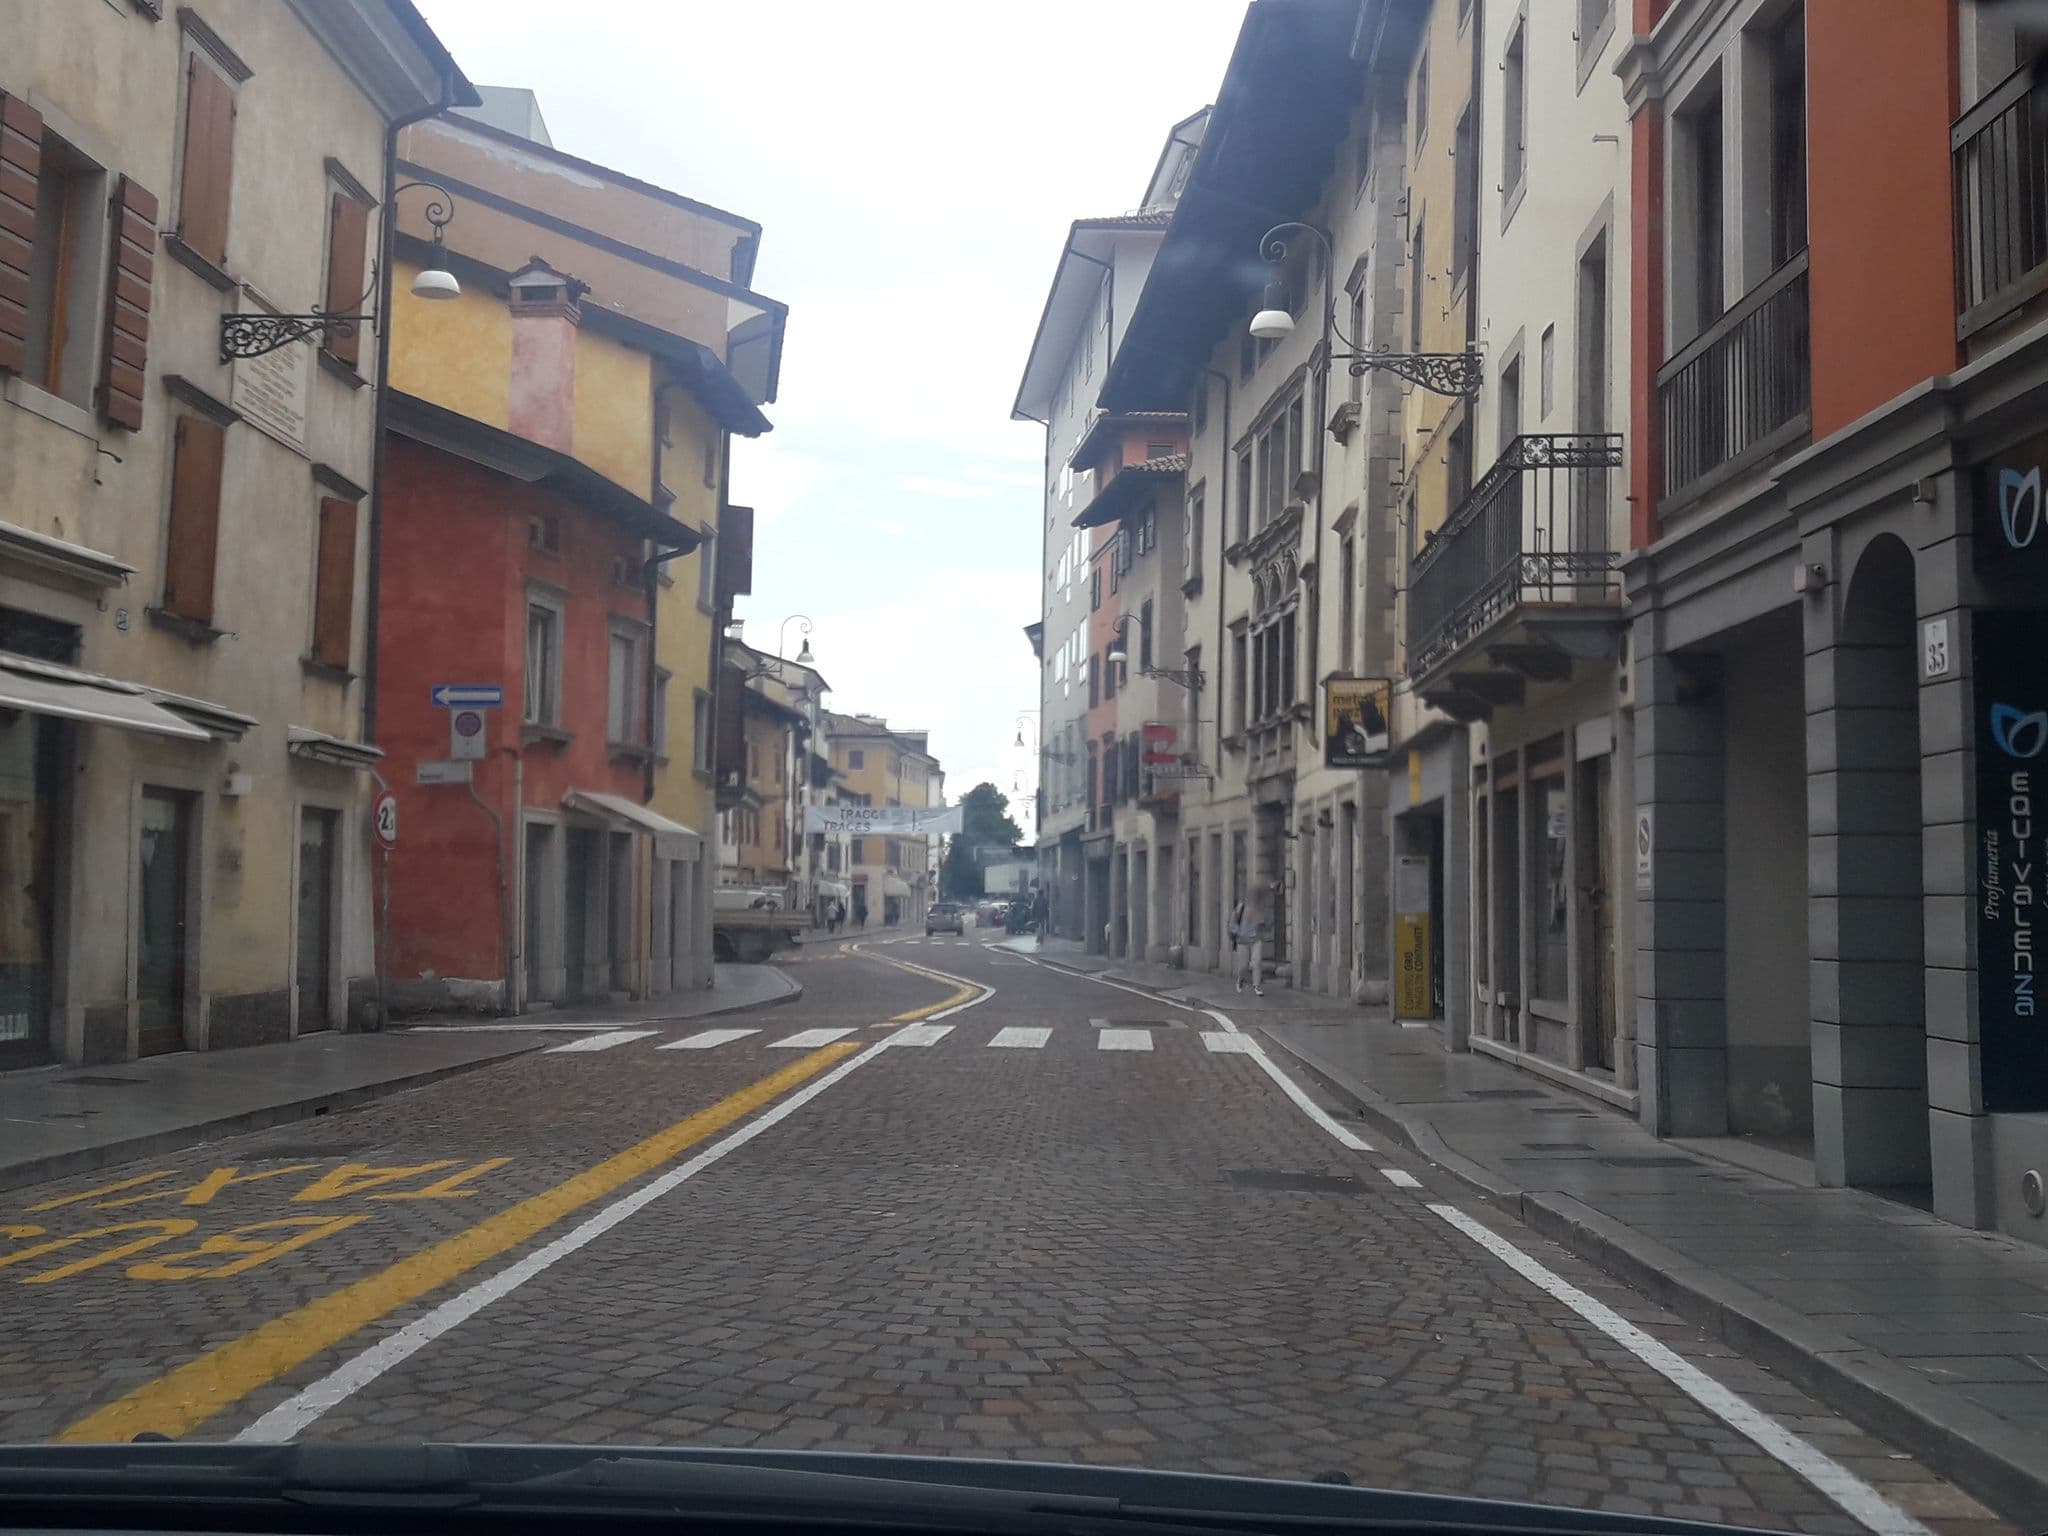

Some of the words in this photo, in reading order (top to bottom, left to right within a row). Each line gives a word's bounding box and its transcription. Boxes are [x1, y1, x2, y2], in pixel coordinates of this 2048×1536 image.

[1928, 642, 1945, 672] 35
[1983, 830, 2005, 921] Profumeria
[24, 1157, 515, 1211] TAXI
